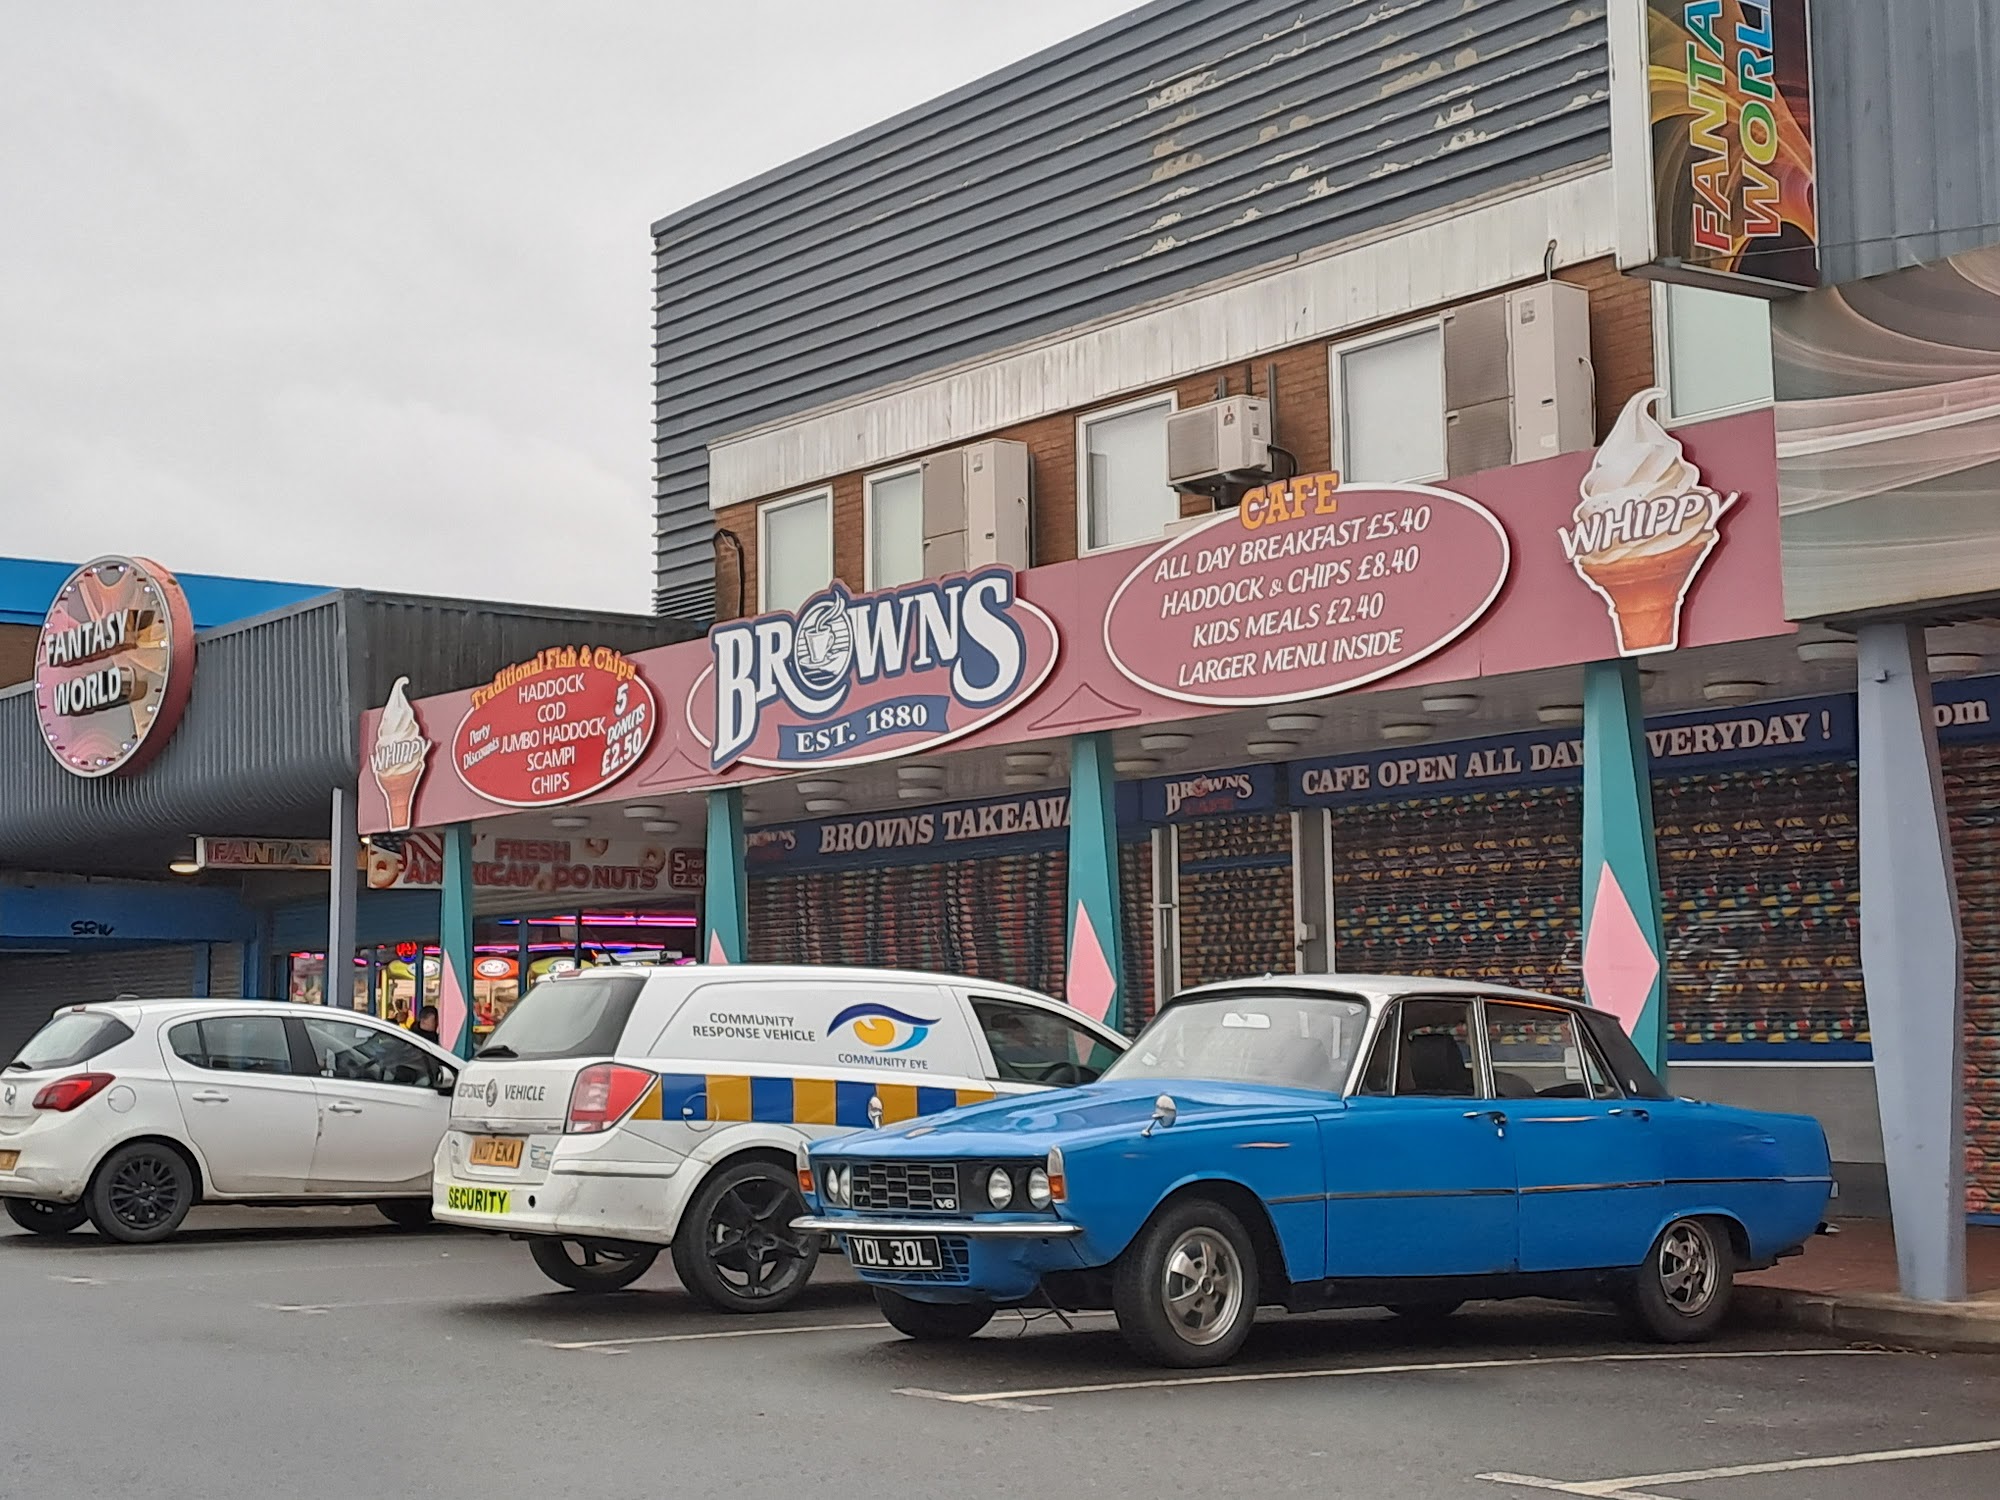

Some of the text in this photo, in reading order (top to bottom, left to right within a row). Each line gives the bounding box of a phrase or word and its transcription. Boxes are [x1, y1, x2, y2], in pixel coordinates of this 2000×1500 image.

[1736, 0, 1783, 238] WORL
[1239, 471, 1340, 530] CAFE
[1154, 505, 1432, 583] ALL DAY BREAKFAST £5.40
[1557, 490, 1742, 561] WHIPPY
[1161, 545, 1420, 619] HADDOCK & CHIPS £8.40
[46, 609, 130, 667] FANTASY
[1192, 592, 1385, 648] KIDS MEALS £2.40
[713, 576, 1020, 762] BROWNS
[1178, 628, 1405, 687] LARGER MENU INSIDE
[54, 666, 121, 716] WORLD
[471, 644, 637, 711] Traditional Fish & Chips
[518, 672, 585, 704] HADDOCK
[537, 701, 566, 723] COD
[614, 682, 629, 717] 5
[1933, 700, 1990, 727] om
[469, 724, 491, 747] Party
[500, 716, 606, 754] JUMBO HADDOCK
[606, 703, 646, 746] DONUTS
[794, 704, 928, 754] EST. 1880
[370, 738, 433, 774] WHIPPY
[527, 746, 575, 772] SCAMPI
[600, 726, 642, 777] £2.50
[1302, 764, 1370, 796] CAFE
[1378, 753, 1458, 788] OPEN
[1464, 746, 1522, 778] ALL
[1645, 711, 1812, 758] VERYDAY
[531, 771, 570, 795] CHIPS
[1165, 774, 1253, 816] BROWNS
[495, 839, 571, 863] FRESH
[819, 813, 935, 853] BROWNS
[552, 863, 658, 890] DONUTS
[673, 852, 687, 872] 5
[693, 1025, 815, 1042] RESPONSE VEHICLE
[709, 1012, 794, 1027] COMMUNITY
[838, 1053, 929, 1070] COMMUNITY EYE
[505, 1084, 546, 1101] VEHICLE
[448, 1186, 508, 1214] SECURITY
[935, 1198, 955, 1210] V8
[892, 1240, 933, 1267] 30L
